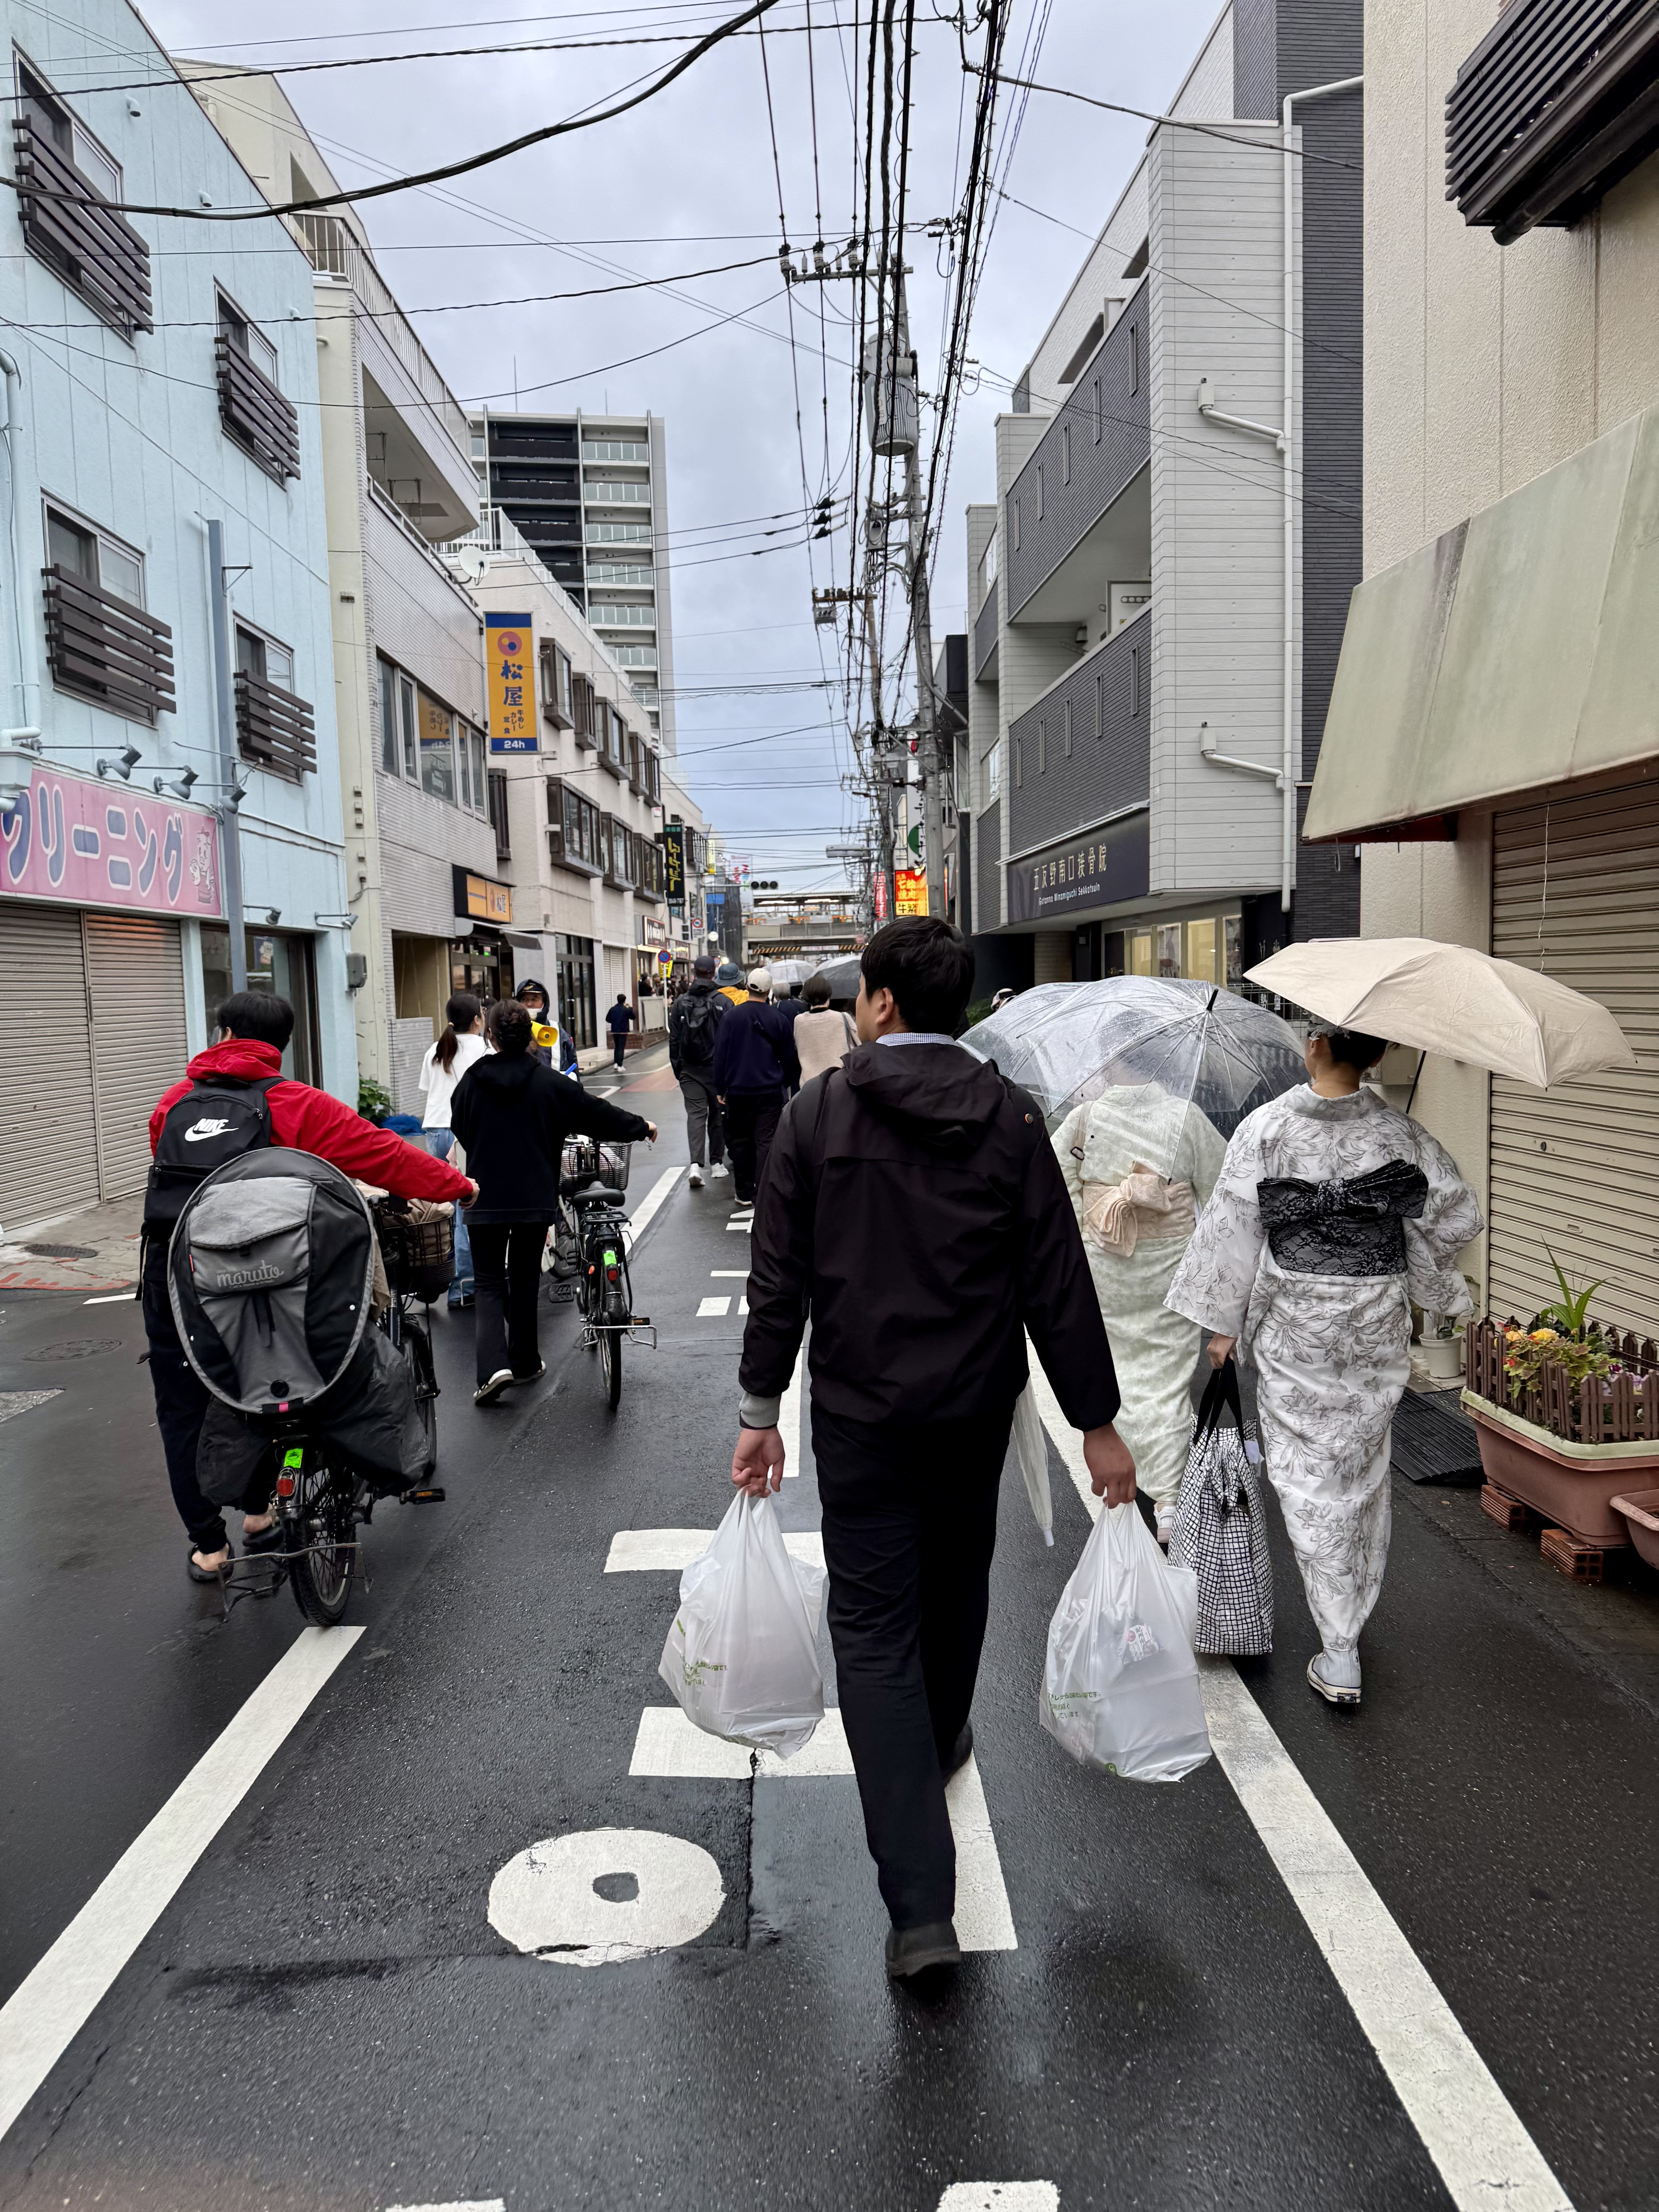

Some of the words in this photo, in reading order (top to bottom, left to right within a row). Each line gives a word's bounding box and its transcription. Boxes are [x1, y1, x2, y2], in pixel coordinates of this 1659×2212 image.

[501, 660, 523, 706] 松屋
[504, 740, 525, 749] 24h
[1, 781, 183, 906] クリーニング
[1034, 843, 1107, 891] 五反野南口接骨院
[194, 1118, 229, 1132] NIKE
[216, 1260, 284, 1288] maruto
